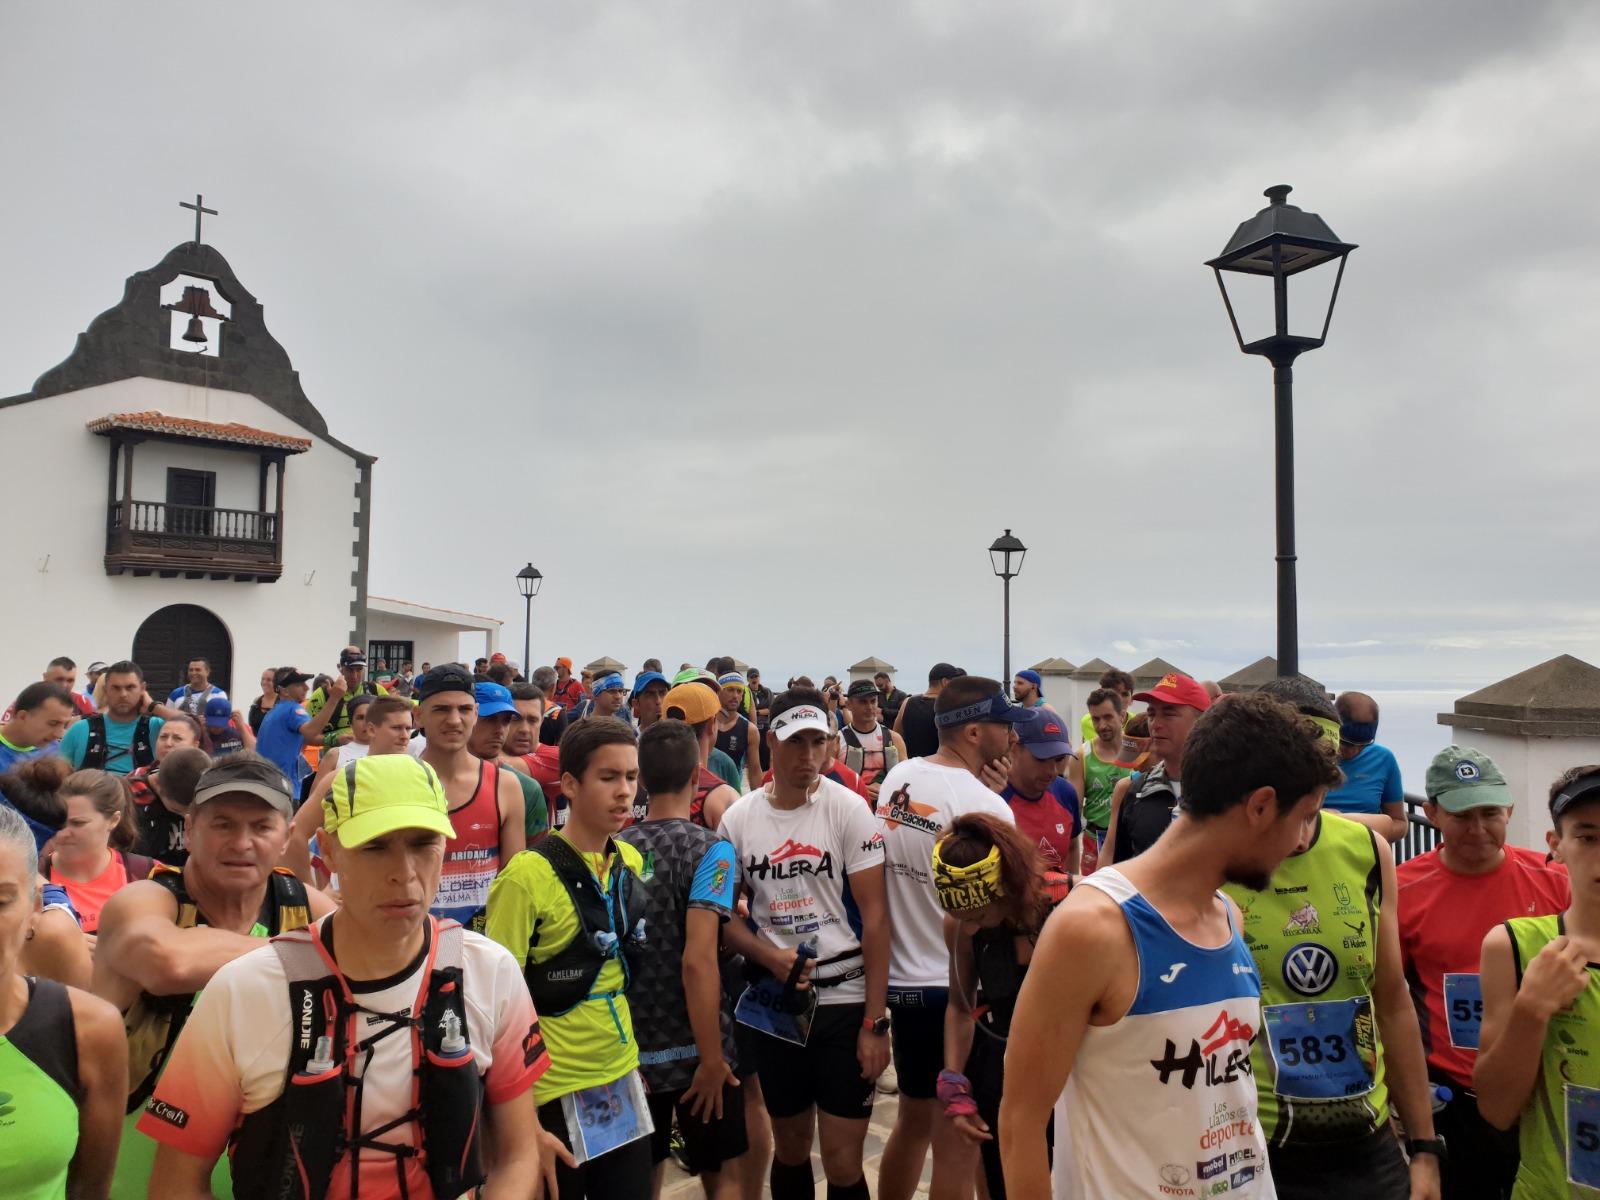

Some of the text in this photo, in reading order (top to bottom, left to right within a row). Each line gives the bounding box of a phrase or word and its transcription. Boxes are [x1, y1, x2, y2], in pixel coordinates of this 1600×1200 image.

[891, 805, 944, 832] Creaciones
[451, 850, 488, 861] ARIDANE
[747, 851, 833, 880] HILERA
[439, 878, 490, 893] LDENT
[443, 894, 471, 904] PALMA
[769, 896, 814, 912] deporte
[301, 989, 313, 1049] AONIJIE
[1453, 1000, 1484, 1022] 55
[1278, 1034, 1346, 1067] 583
[156, 1102, 185, 1124] Craft
[1214, 1102, 1228, 1115] Los
[1209, 1110, 1236, 1129] Llanos
[1576, 1121, 1600, 1152] 5
[1158, 1184, 1195, 1197] TOYOTA
